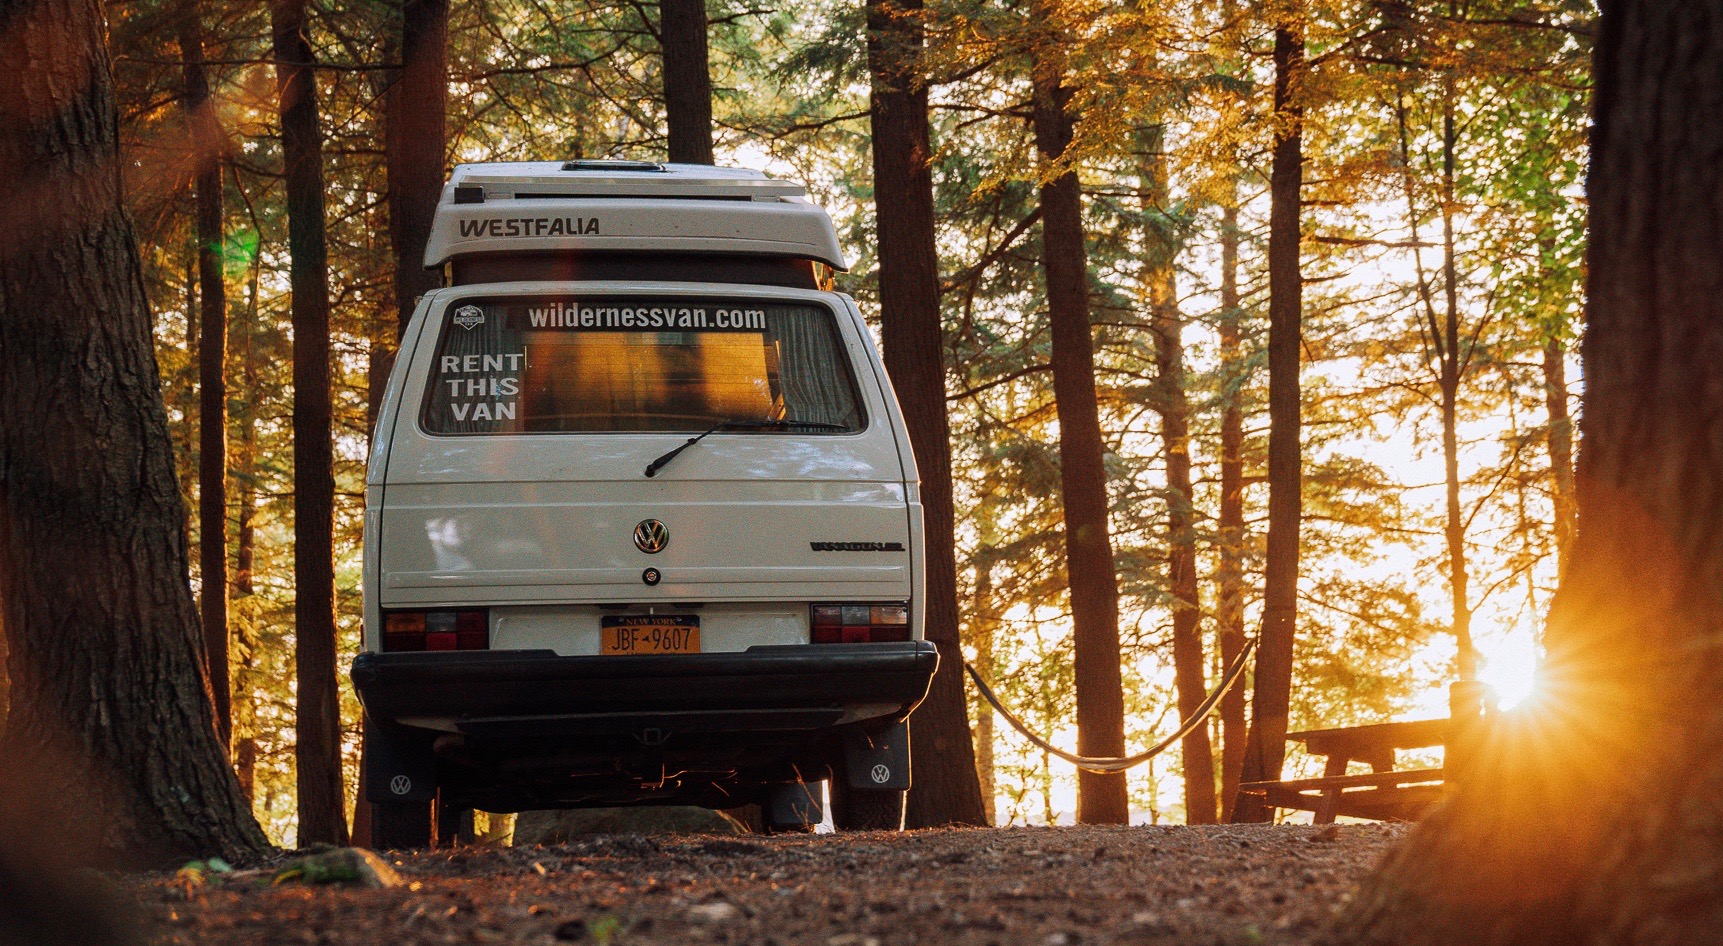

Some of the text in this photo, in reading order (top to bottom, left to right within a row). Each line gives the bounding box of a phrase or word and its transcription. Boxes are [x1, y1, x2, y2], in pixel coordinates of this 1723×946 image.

[459, 217, 600, 238] WESTFALIA
[528, 302, 767, 329] wildernessvan.com
[440, 353, 524, 374] RENT
[446, 377, 520, 398] THIS
[450, 402, 516, 421] VAN
[626, 618, 676, 626] NEW YORK
